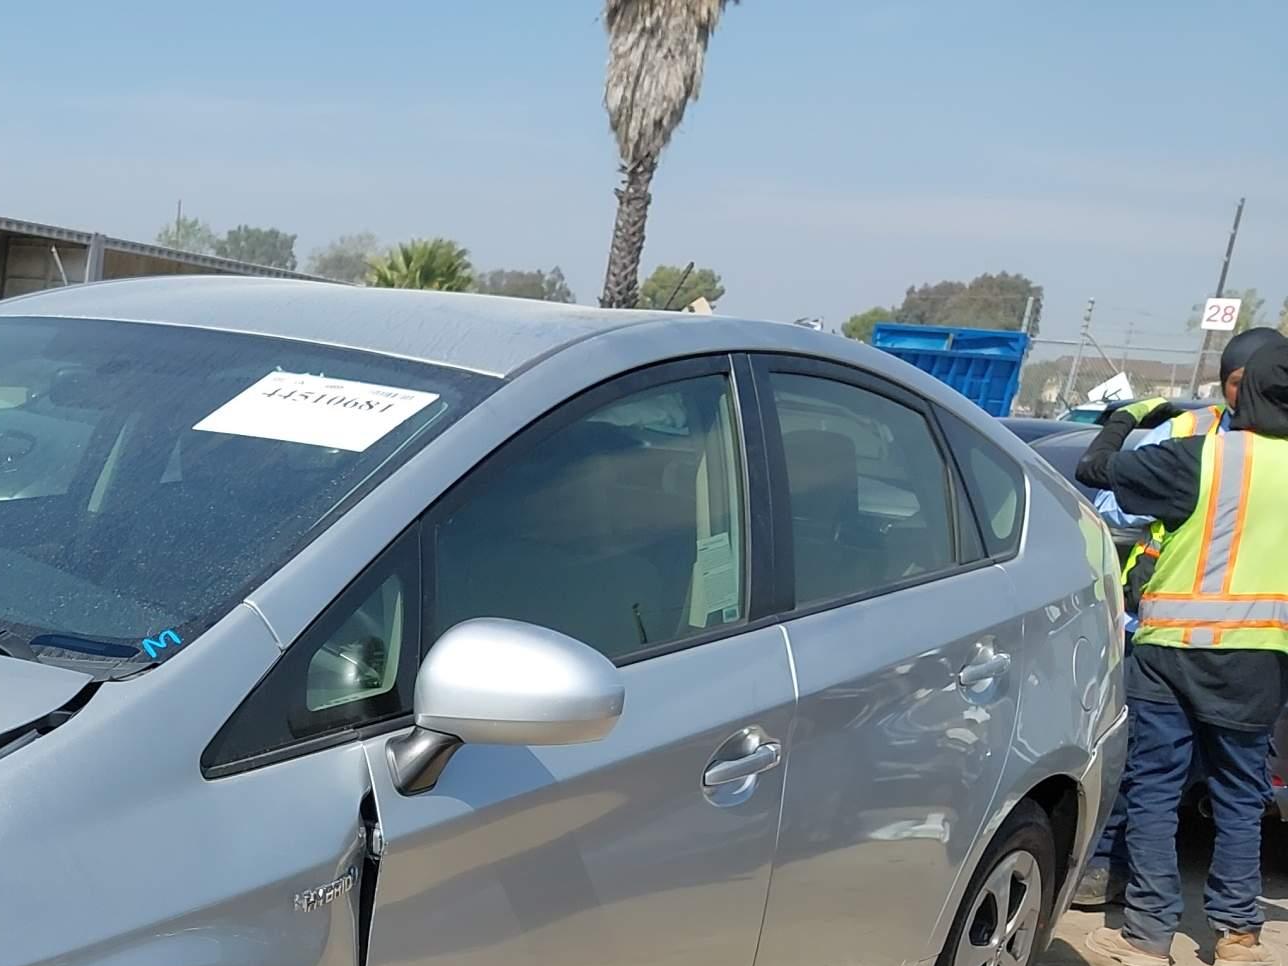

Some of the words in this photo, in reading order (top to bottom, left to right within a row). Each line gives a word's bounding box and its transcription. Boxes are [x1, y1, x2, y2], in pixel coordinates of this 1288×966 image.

[1205, 305, 1236, 323] 28
[261, 387, 395, 413] 44510681
[142, 629, 181, 658] M
